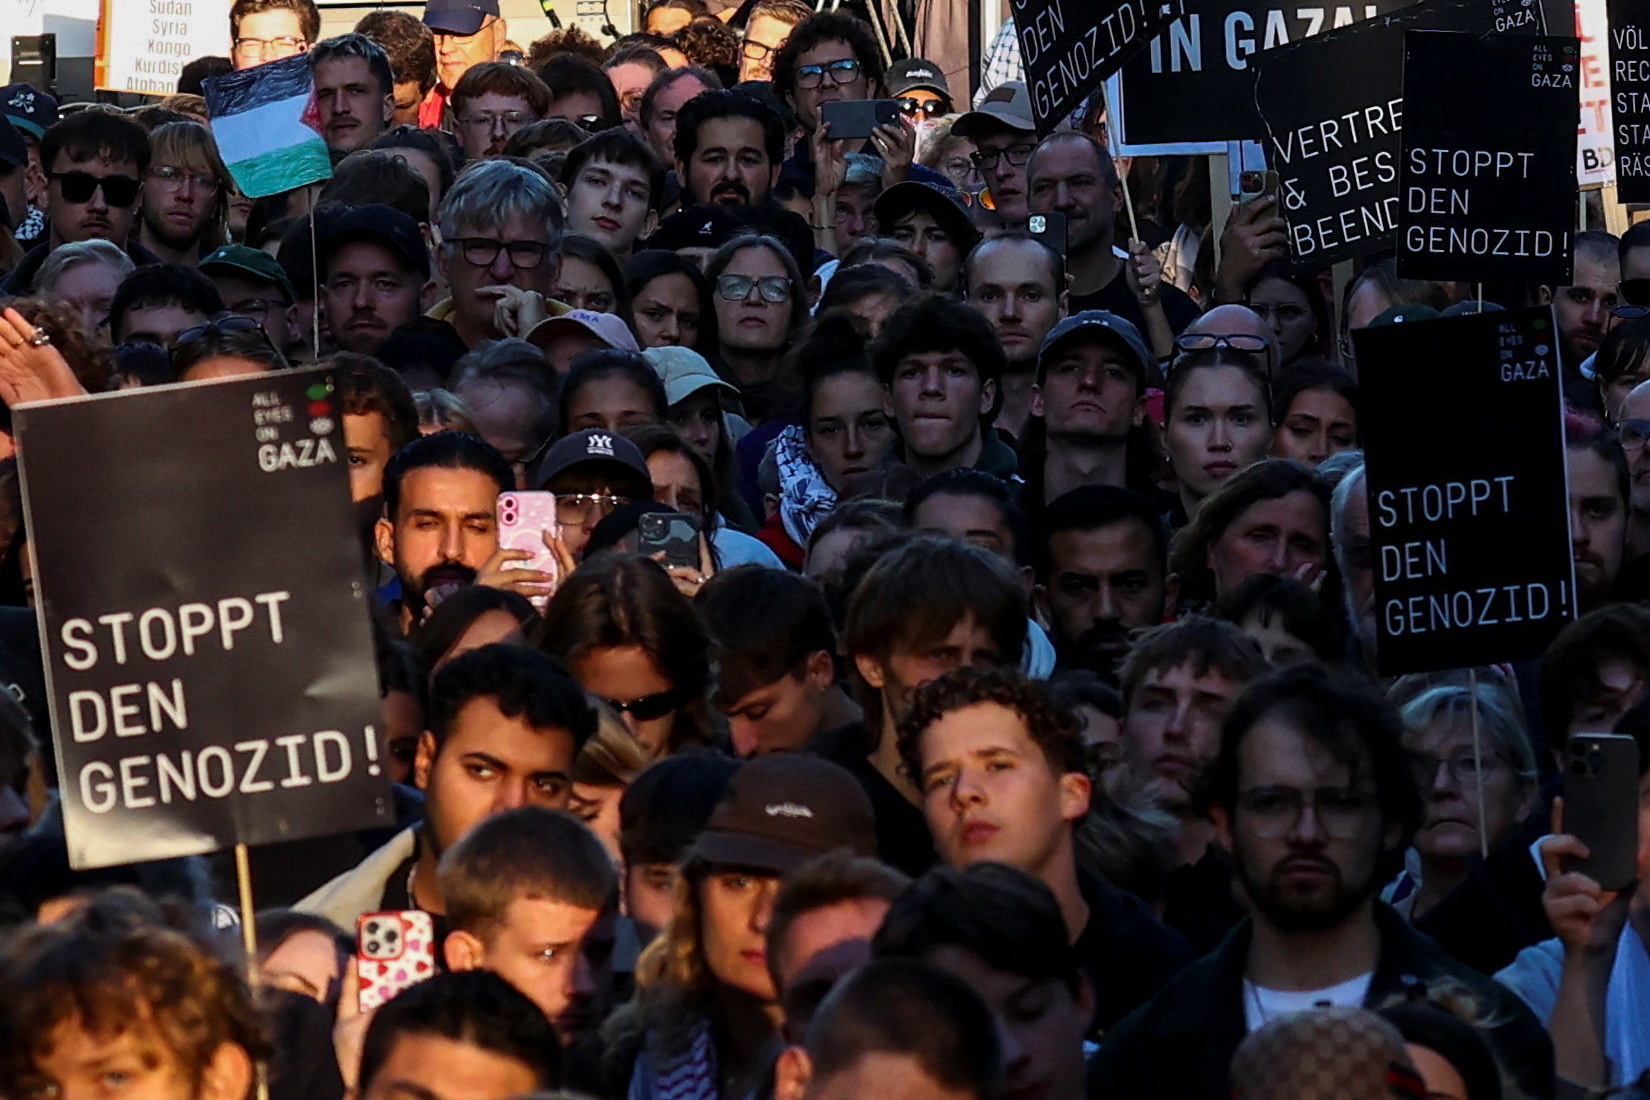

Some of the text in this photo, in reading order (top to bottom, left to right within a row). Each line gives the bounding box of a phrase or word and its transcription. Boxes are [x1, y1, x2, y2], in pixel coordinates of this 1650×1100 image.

[150, 0, 192, 15] Sudan
[152, 19, 187, 36] Syria
[1495, 9, 1536, 33] GAZA
[148, 39, 191, 57] Kongo
[1150, 4, 1377, 74] IN GAZ
[1533, 45, 1548, 53] ALL
[135, 57, 184, 75] Kurdis
[1532, 63, 1543, 71] ON
[1533, 54, 1553, 62] EYES
[127, 76, 174, 93] Afghan
[1531, 73, 1573, 88] GAZA
[1273, 98, 1403, 163] VERTRE
[1409, 148, 1534, 178] STOPPT
[1285, 151, 1396, 210] & BES
[1408, 187, 1470, 216] DEN
[1293, 197, 1399, 256] BEEND
[1407, 226, 1568, 258] GENOZID!
[1501, 360, 1549, 382] GAZA
[252, 391, 279, 408] ALL
[254, 406, 294, 424] EYES
[255, 425, 279, 443] ON
[258, 438, 338, 474] GAZA
[1378, 476, 1515, 527] STOPPT
[1381, 538, 1447, 582] DEN
[1385, 580, 1568, 636] GENOZID!
[61, 590, 291, 670] STOPPT
[69, 678, 188, 744] DEN
[79, 724, 382, 815] GENOZID!
